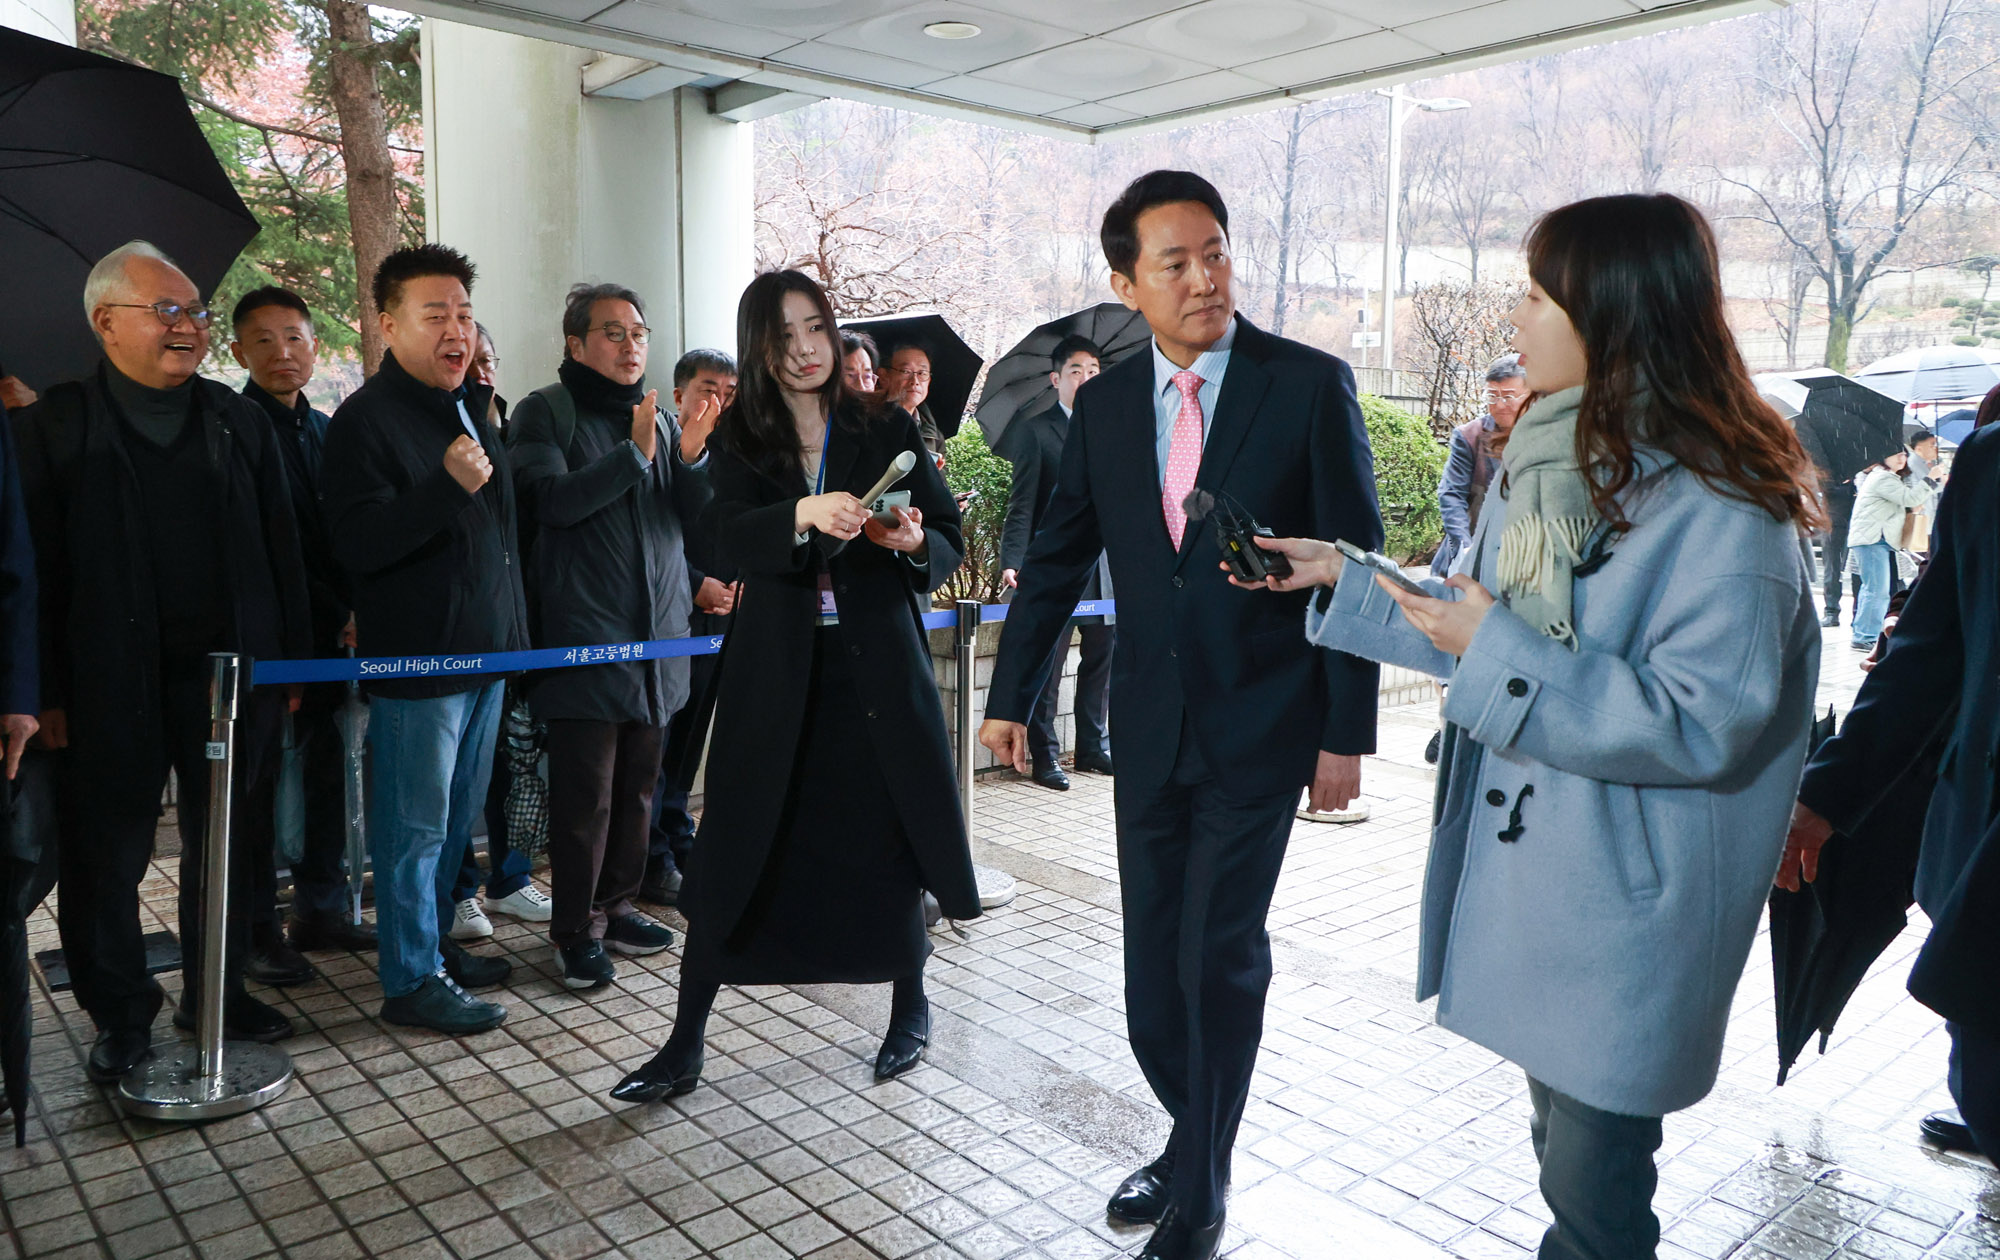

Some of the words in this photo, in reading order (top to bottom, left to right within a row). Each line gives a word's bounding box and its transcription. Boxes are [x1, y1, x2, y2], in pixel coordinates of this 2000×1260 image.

[563, 643, 644, 664] 서울고등법원
[360, 659, 402, 674] Seoul
[405, 658, 439, 675] High
[443, 657, 483, 670] Court
